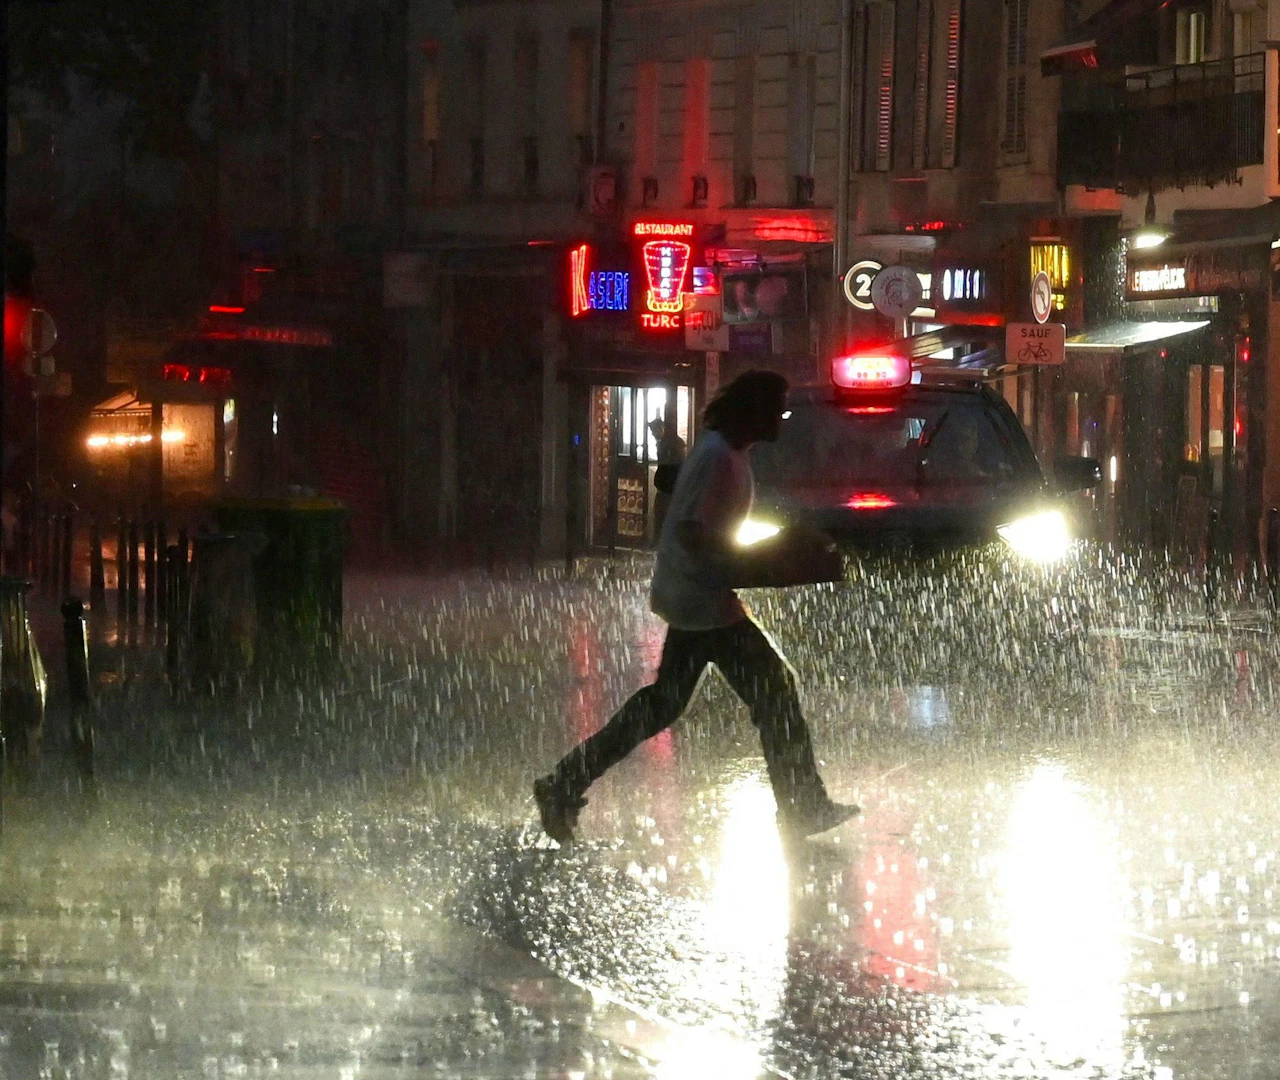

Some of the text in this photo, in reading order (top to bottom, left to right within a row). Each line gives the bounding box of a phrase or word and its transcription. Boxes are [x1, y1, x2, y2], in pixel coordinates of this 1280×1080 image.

[635, 223, 694, 236] RESTAURANT
[641, 313, 680, 328] TURC
[1021, 328, 1051, 339] SAUF
